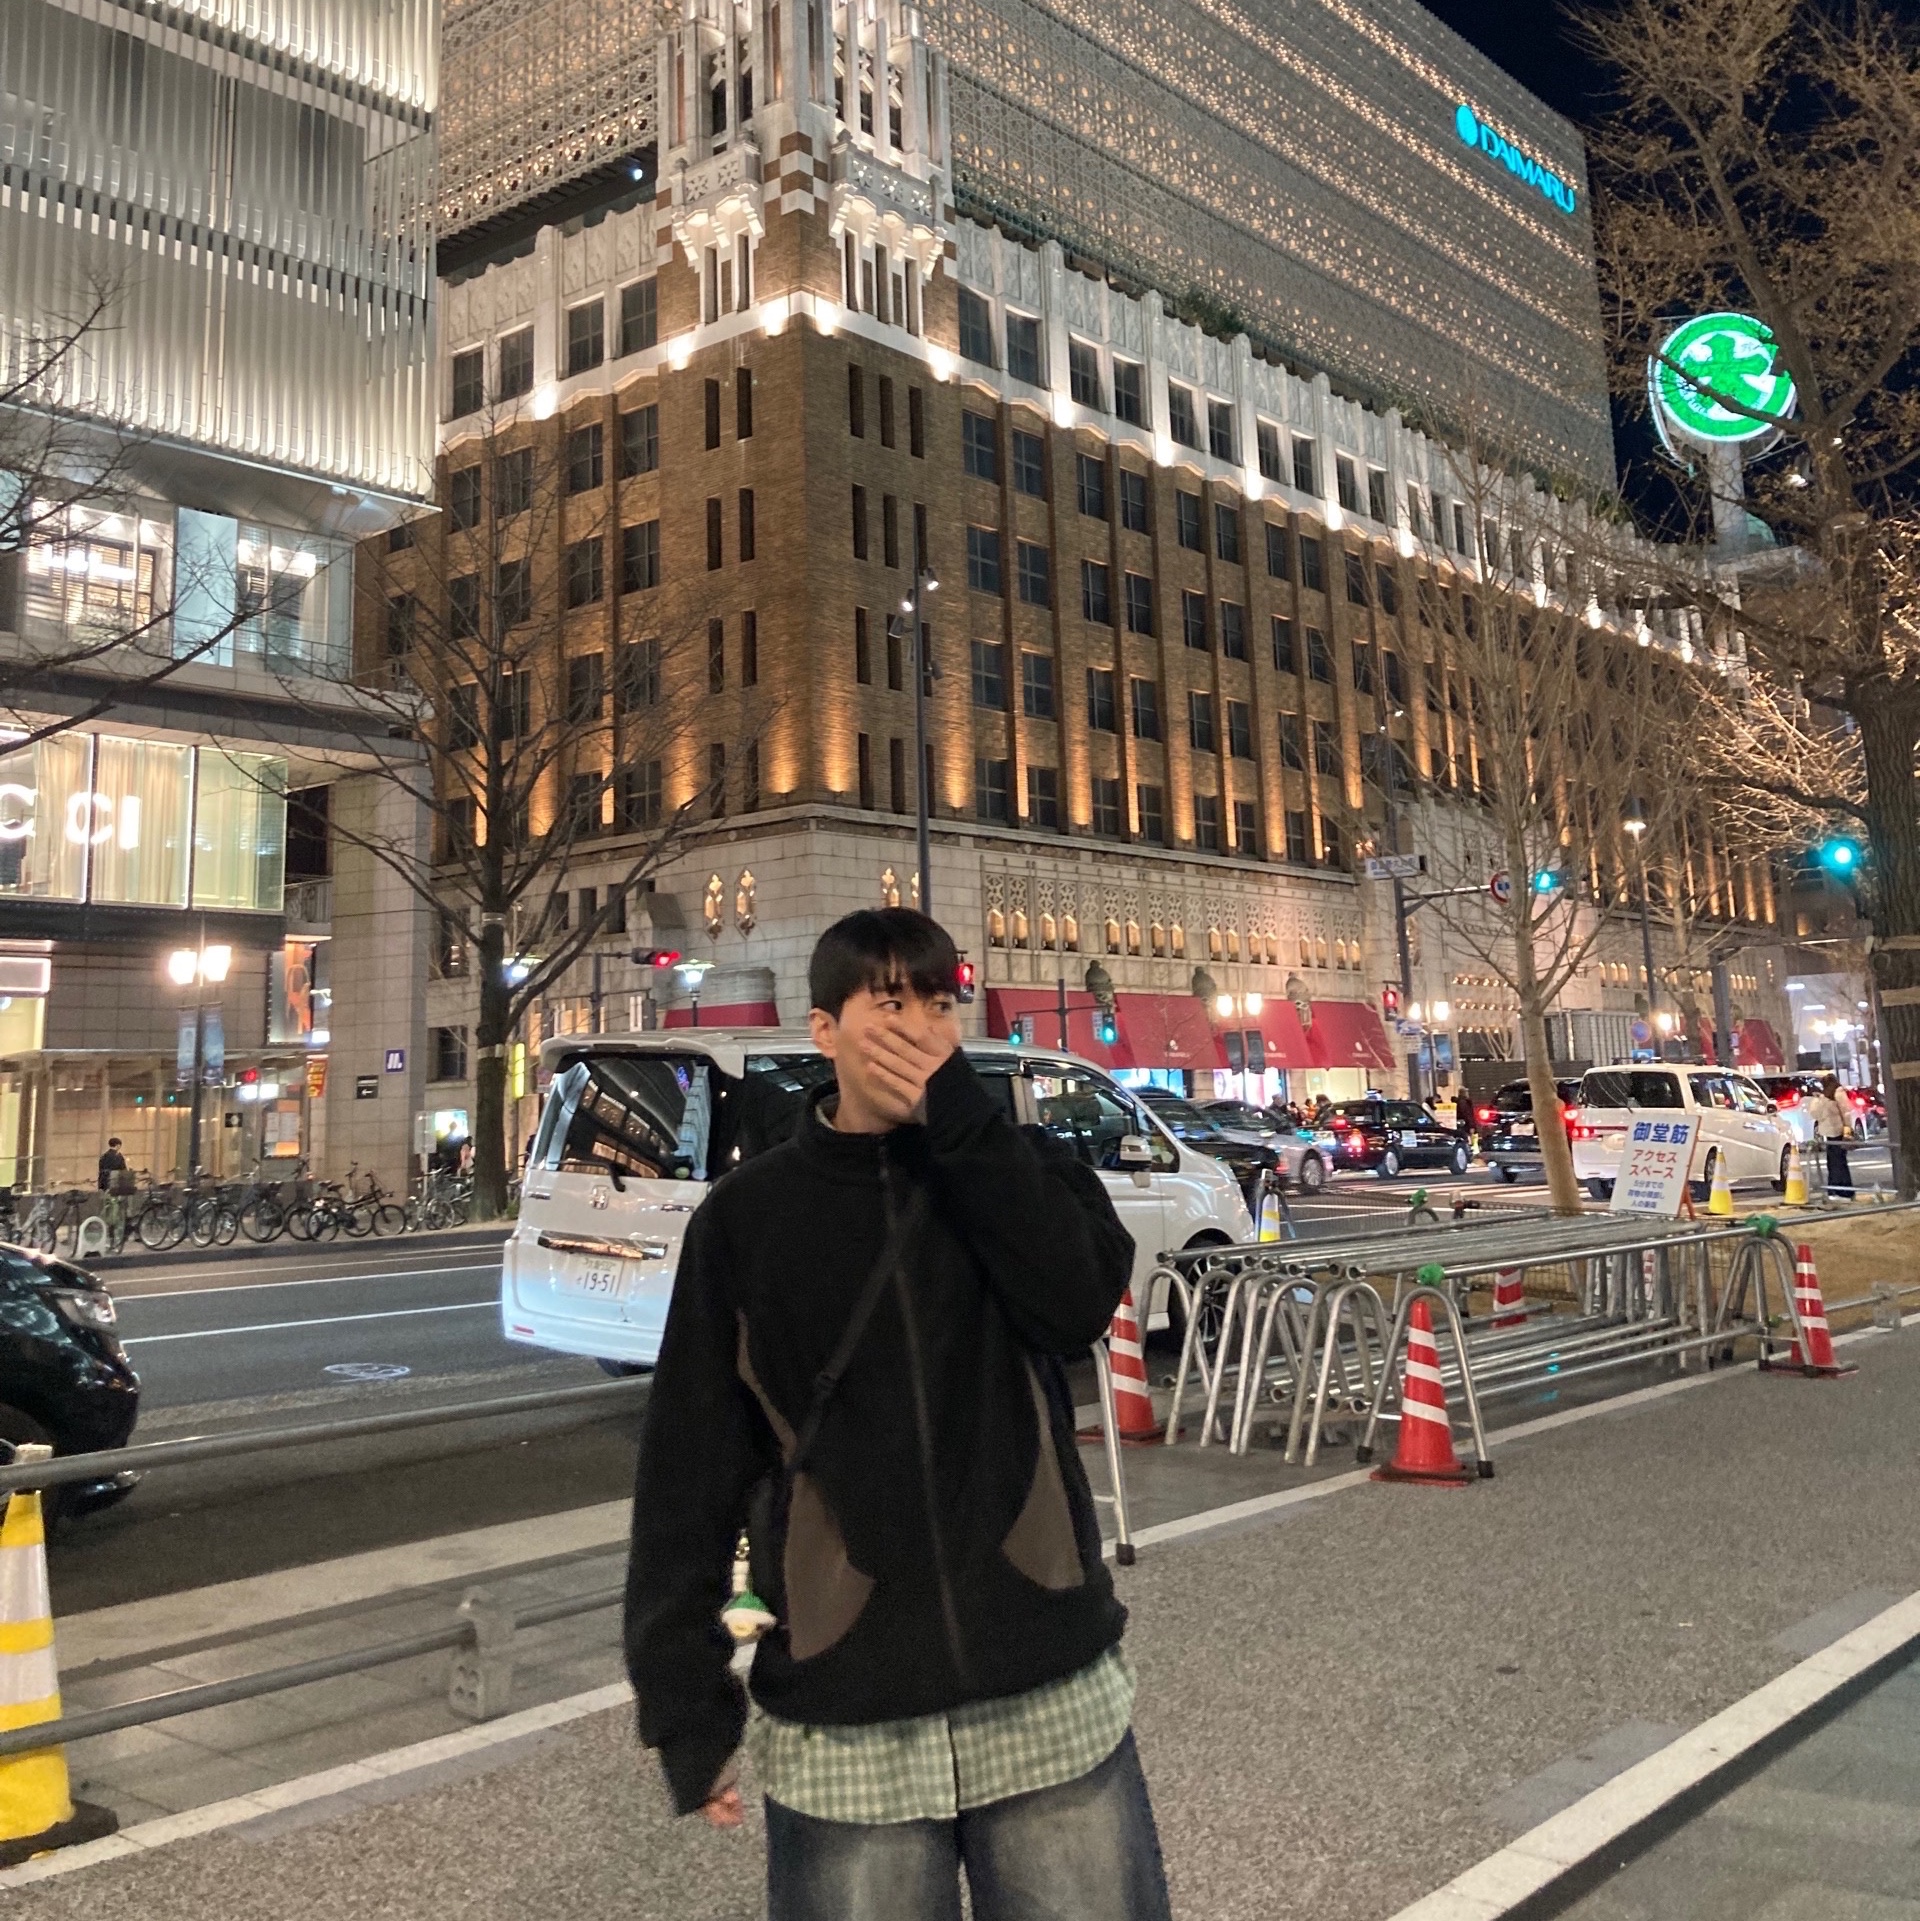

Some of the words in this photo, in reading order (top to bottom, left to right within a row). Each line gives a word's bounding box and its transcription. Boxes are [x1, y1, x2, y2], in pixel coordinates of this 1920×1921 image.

[1480, 124, 1576, 214] DAIMARU
[1633, 1121, 1690, 1145] 御堂筋
[1632, 1149, 1677, 1163] アクセス
[1629, 1164, 1674, 1179] スペース
